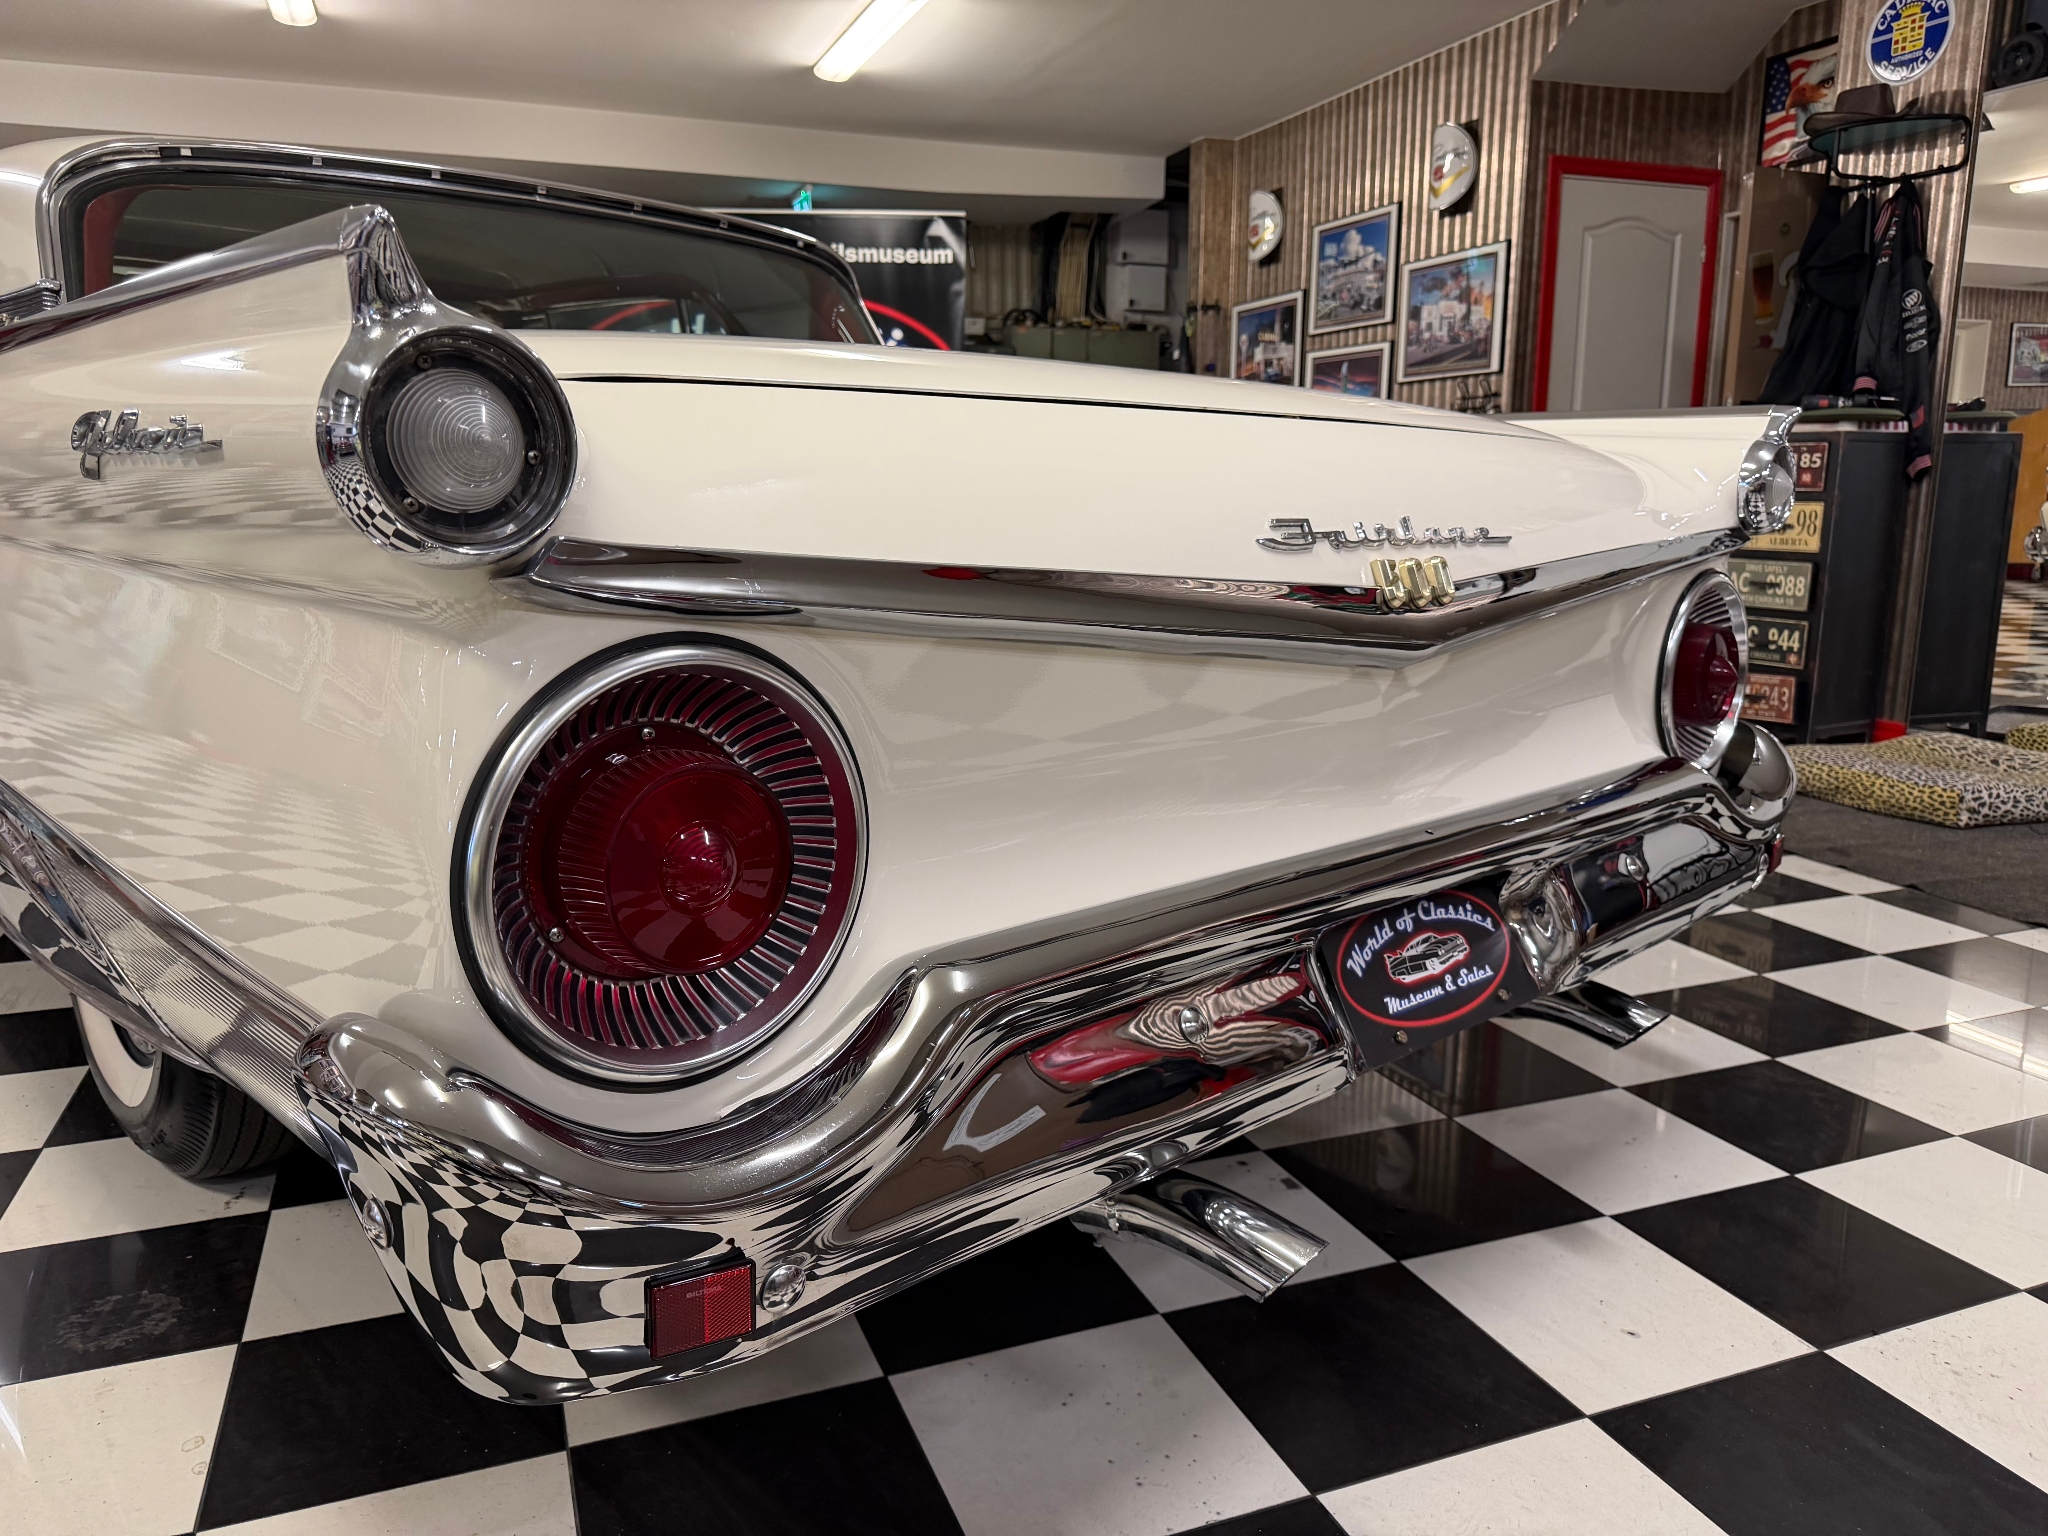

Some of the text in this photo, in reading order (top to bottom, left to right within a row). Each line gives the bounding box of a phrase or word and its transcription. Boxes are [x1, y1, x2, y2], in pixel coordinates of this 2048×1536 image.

[1880, 47, 1936, 77] SERVICE
[1891, 50, 1923, 63] AUTHORIZED
[1255, 515, 1513, 551] Fairlane
[1769, 537, 1809, 547] ALBERTA
[1369, 555, 1456, 610] 500
[1346, 900, 1496, 978] World of Classics
[1383, 964, 1494, 1015] Museum & Sales
